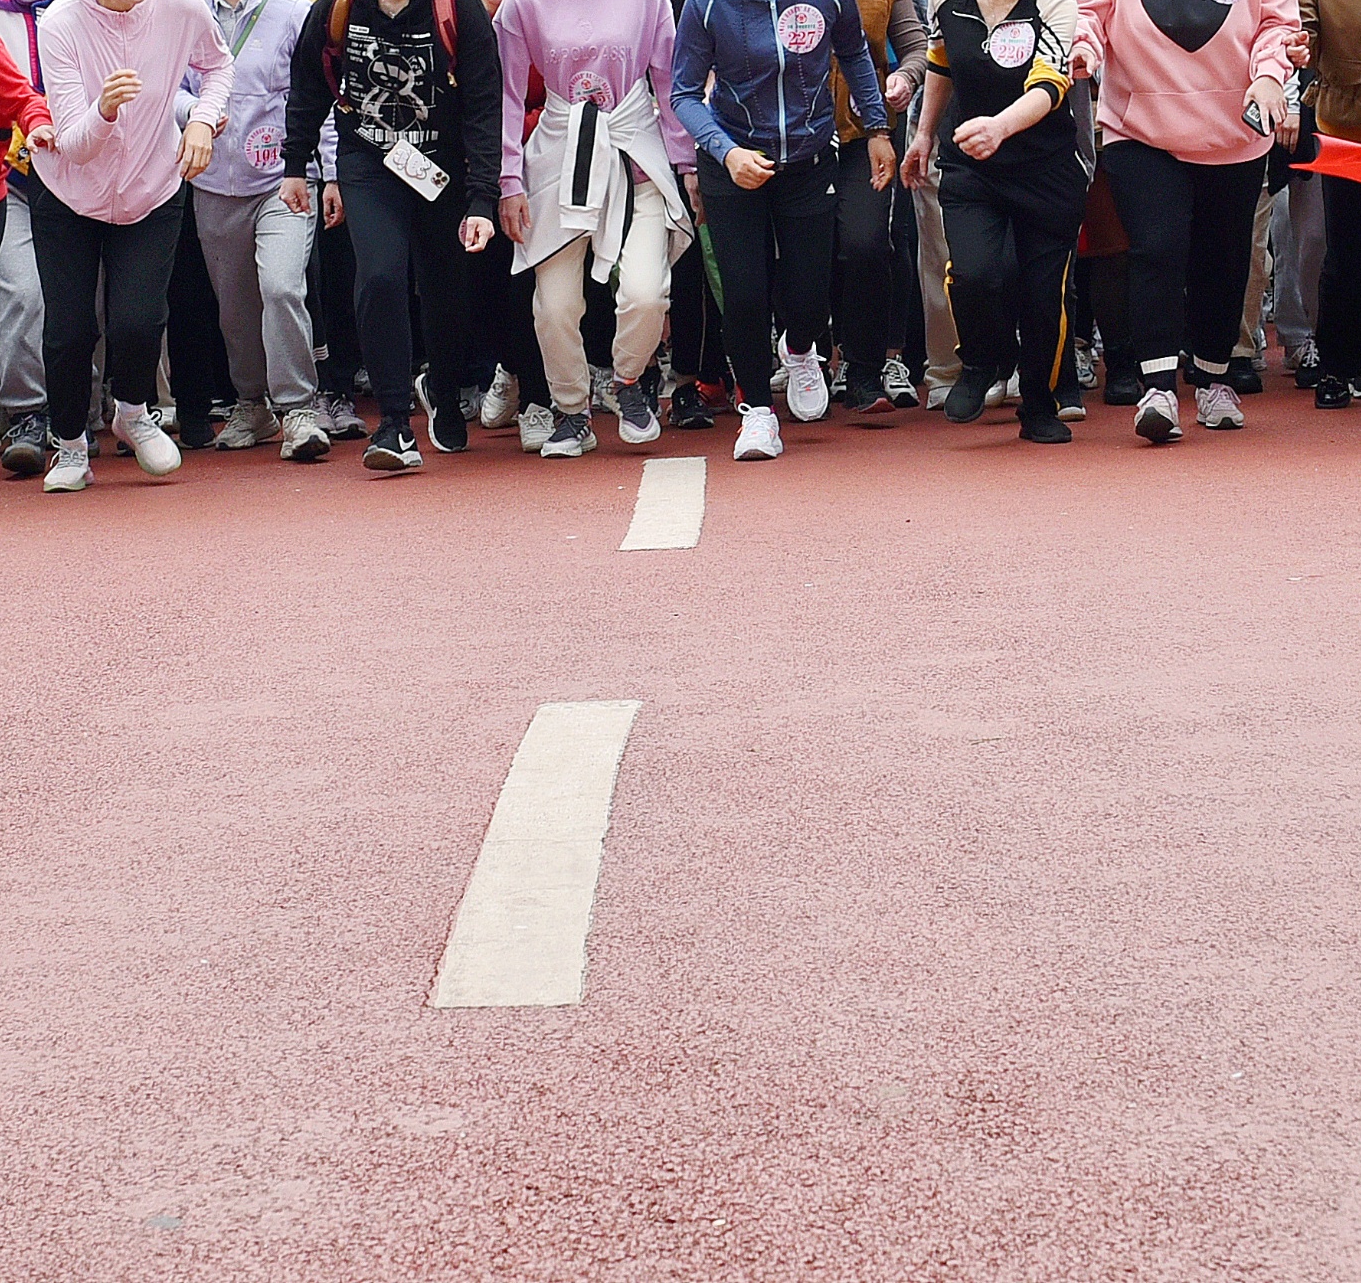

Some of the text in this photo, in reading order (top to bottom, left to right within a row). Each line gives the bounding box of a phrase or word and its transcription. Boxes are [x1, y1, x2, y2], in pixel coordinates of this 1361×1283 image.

[788, 31, 816, 46] 227
[998, 45, 1025, 60] 226
[255, 147, 278, 163] 104
